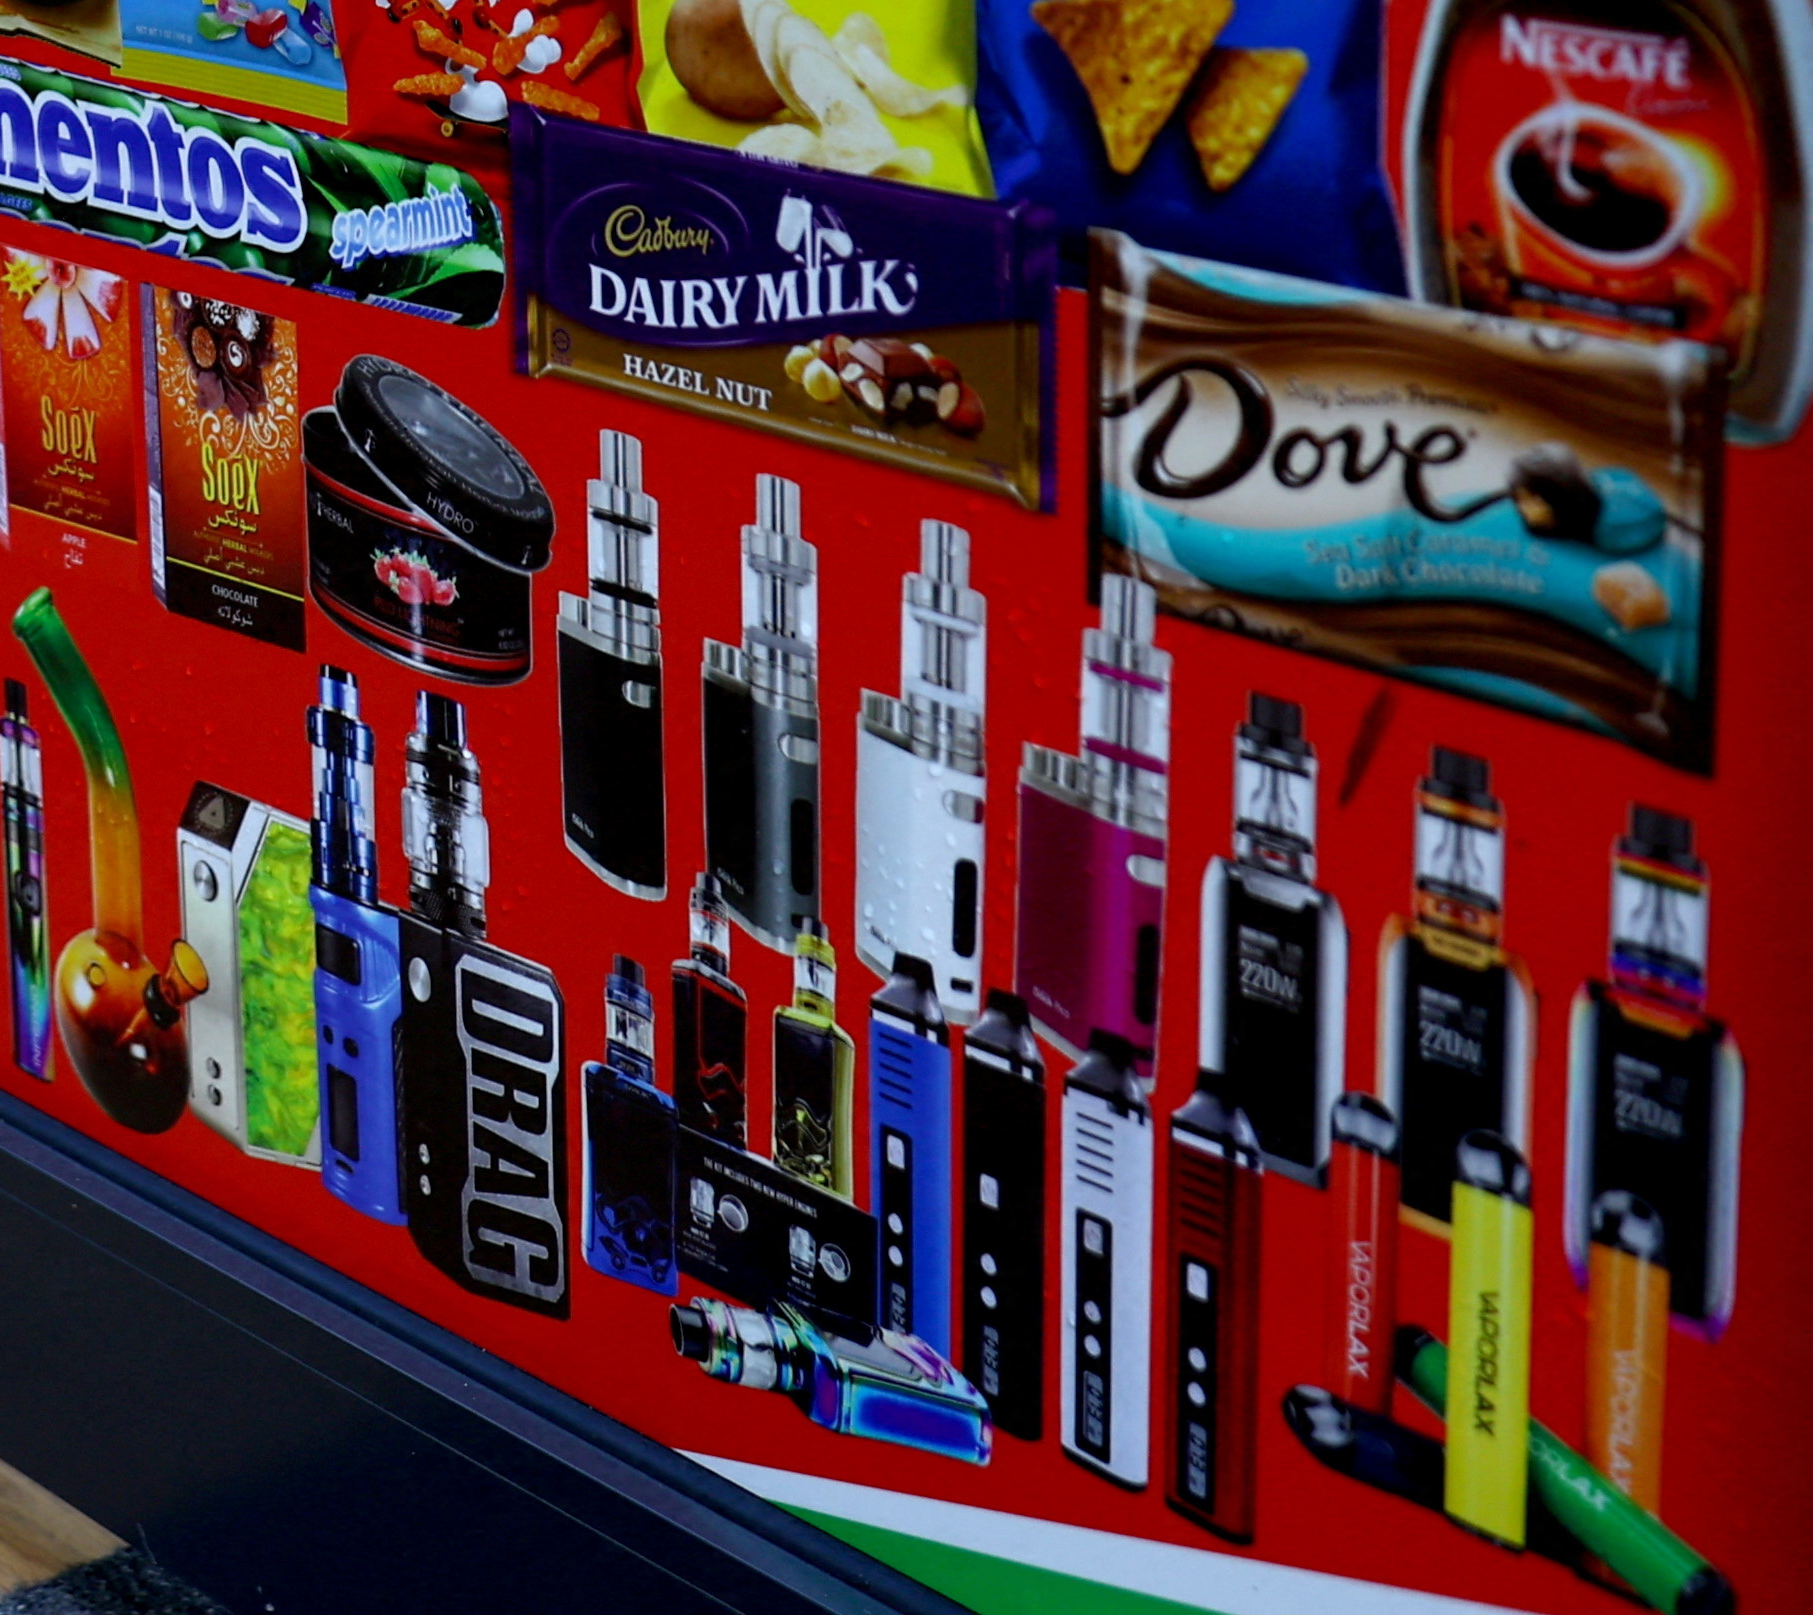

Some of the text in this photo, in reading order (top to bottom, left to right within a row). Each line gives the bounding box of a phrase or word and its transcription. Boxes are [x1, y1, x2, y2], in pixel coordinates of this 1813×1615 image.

[1500, 12, 1692, 89] NESCAFÉ
[330, 185, 476, 268] spearmint
[604, 203, 713, 259] Cadbury
[588, 256, 919, 329] DAIRY MILK
[623, 352, 774, 413] HAZEL NUT
[1101, 355, 1510, 524] Dove
[61, 533, 87, 549] APPLE
[425, 491, 475, 535] HYDRO
[1303, 535, 1351, 565] Sea
[1353, 535, 1405, 563] Salt
[1406, 529, 1521, 562] Caramel
[1332, 557, 1546, 593] Dark Chocolate
[211, 583, 259, 608] CHOCOLATE
[458, 959, 566, 1296] DRAG
[1346, 1240, 1372, 1380] VAPORLAX
[1472, 1289, 1501, 1438] VAPORLAX
